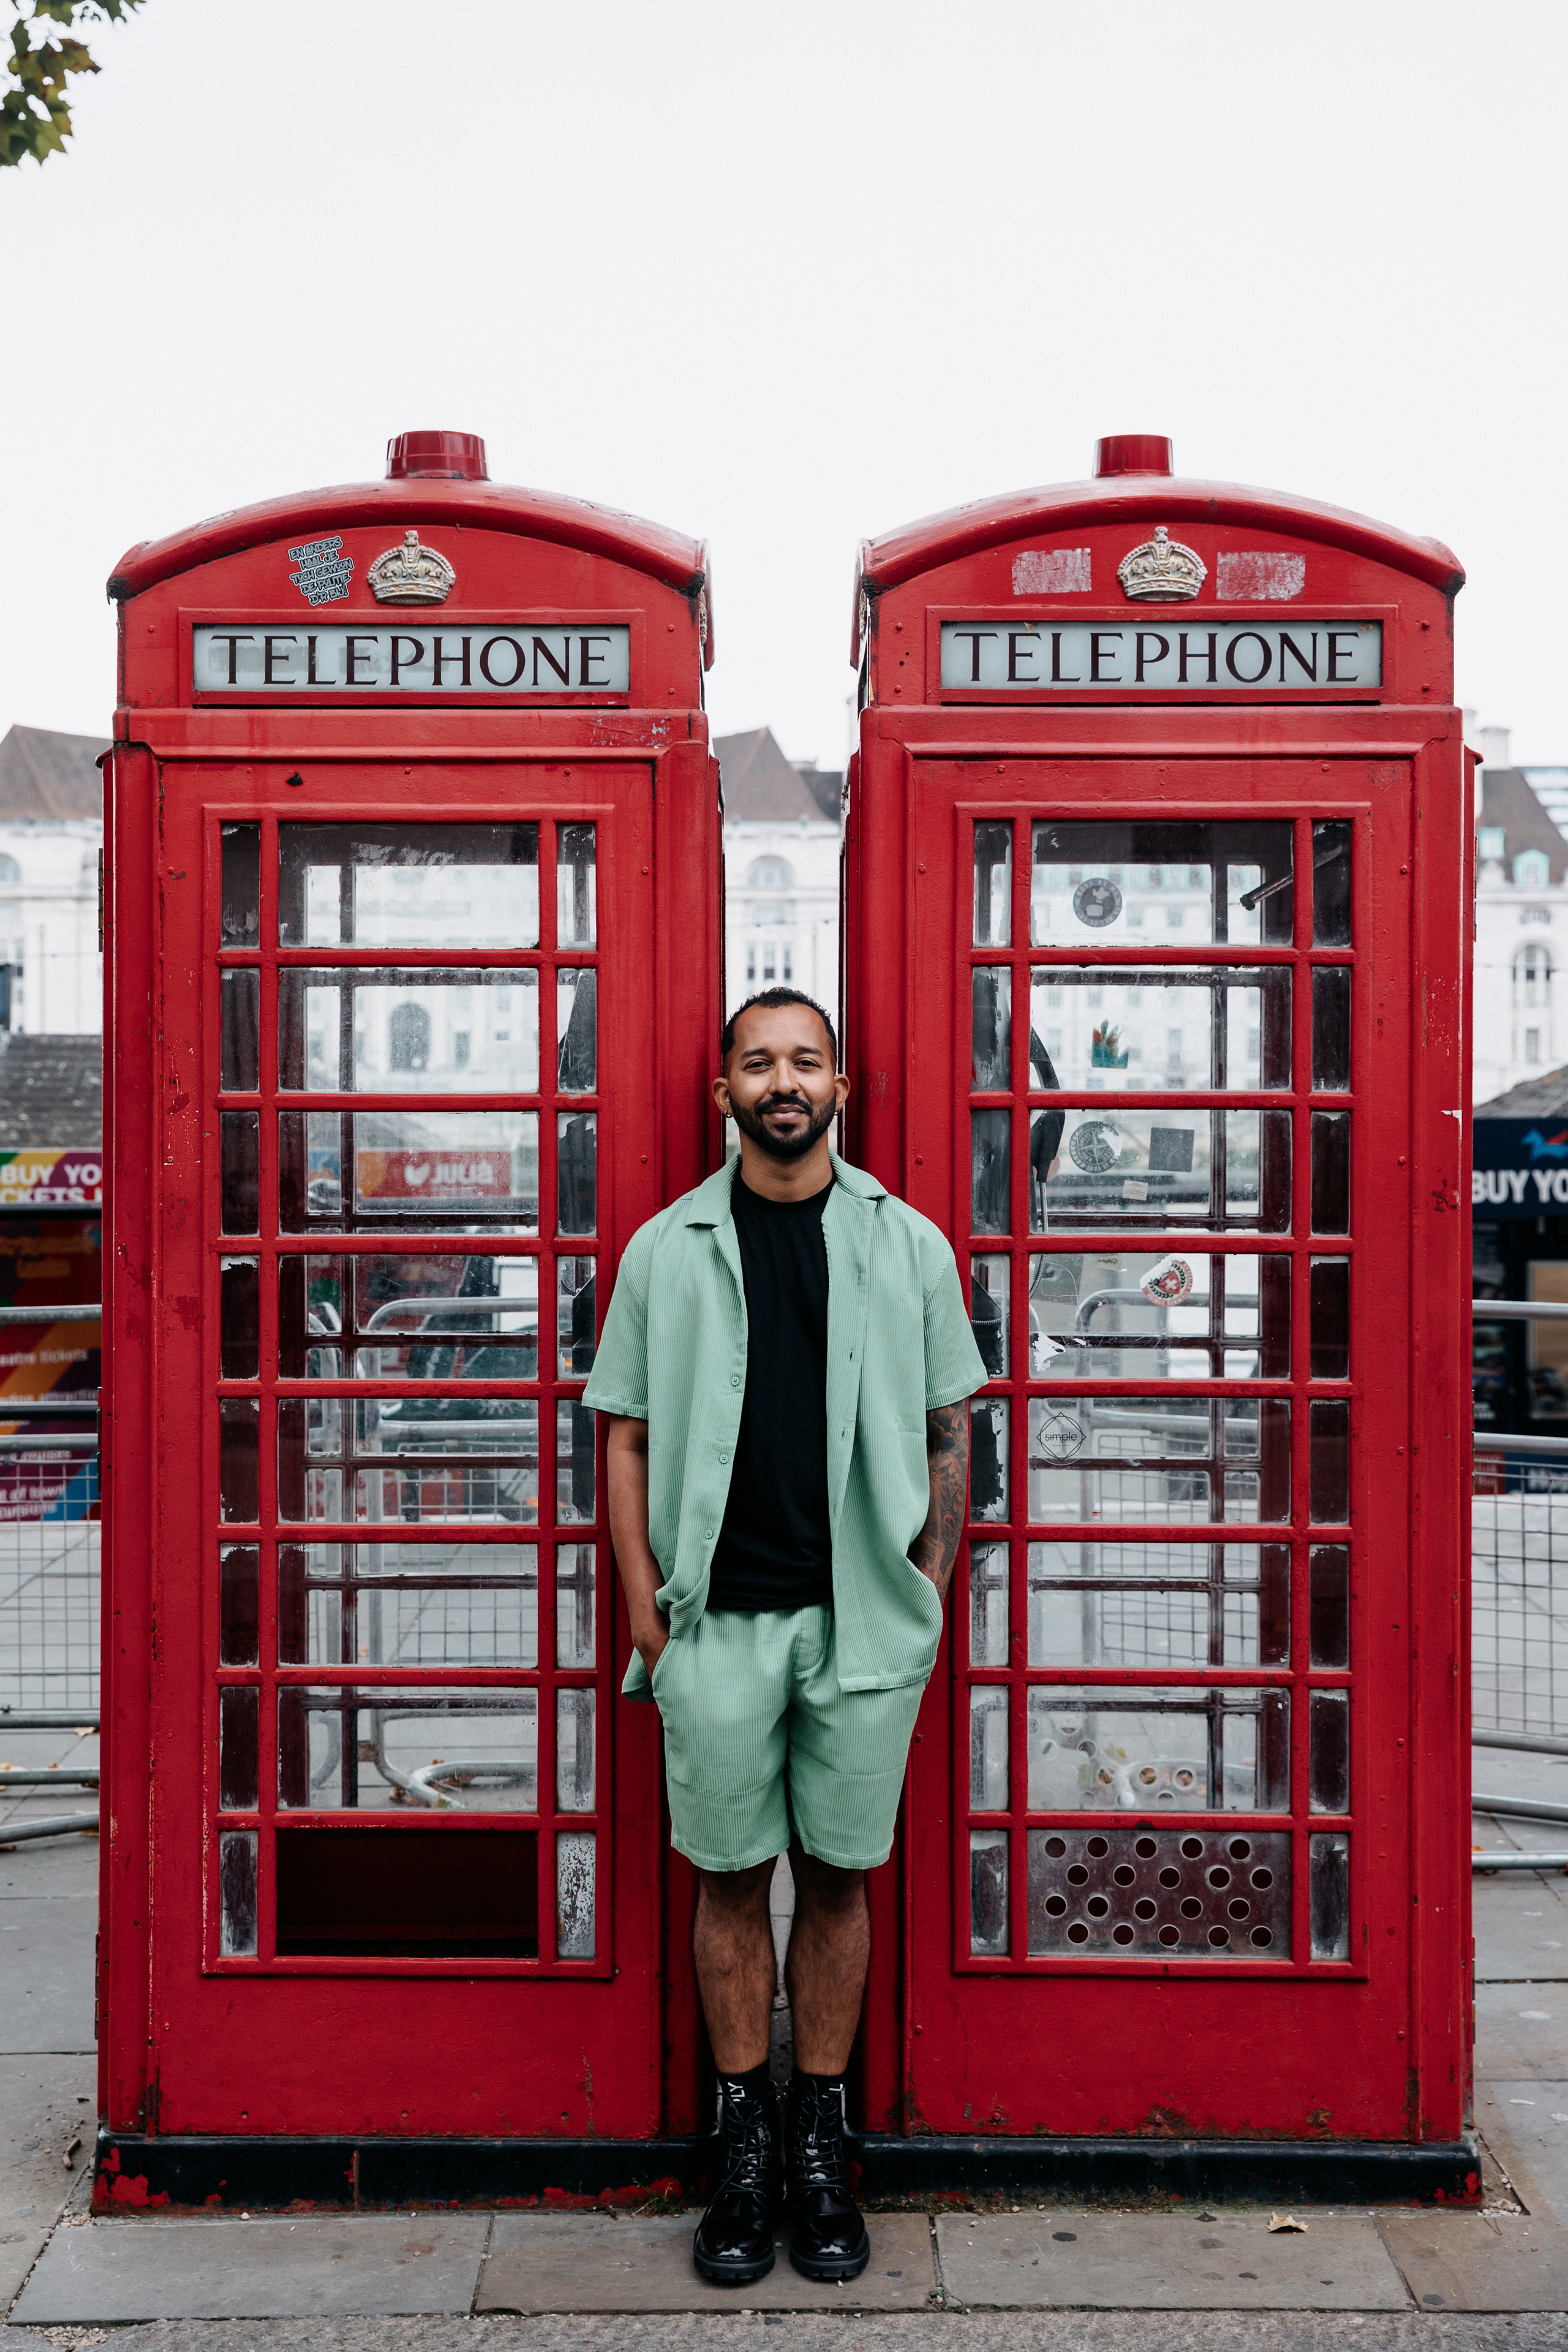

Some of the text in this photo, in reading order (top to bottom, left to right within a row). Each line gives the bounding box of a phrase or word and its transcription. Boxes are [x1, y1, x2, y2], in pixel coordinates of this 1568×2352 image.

[290, 537, 342, 560] EN ANDERS
[290, 559, 353, 585] TOCH GEWOON
[300, 551, 338, 570] HAAL JE
[301, 572, 351, 595] DE POLITIE
[309, 591, 328, 605] D'R
[209, 635, 611, 687] TELEPHONE
[953, 631, 1360, 683] TELEPHONE
[1, 1164, 55, 1186] BUY
[1472, 1169, 1530, 1204] BUY
[1045, 1432, 1077, 1443] simple
